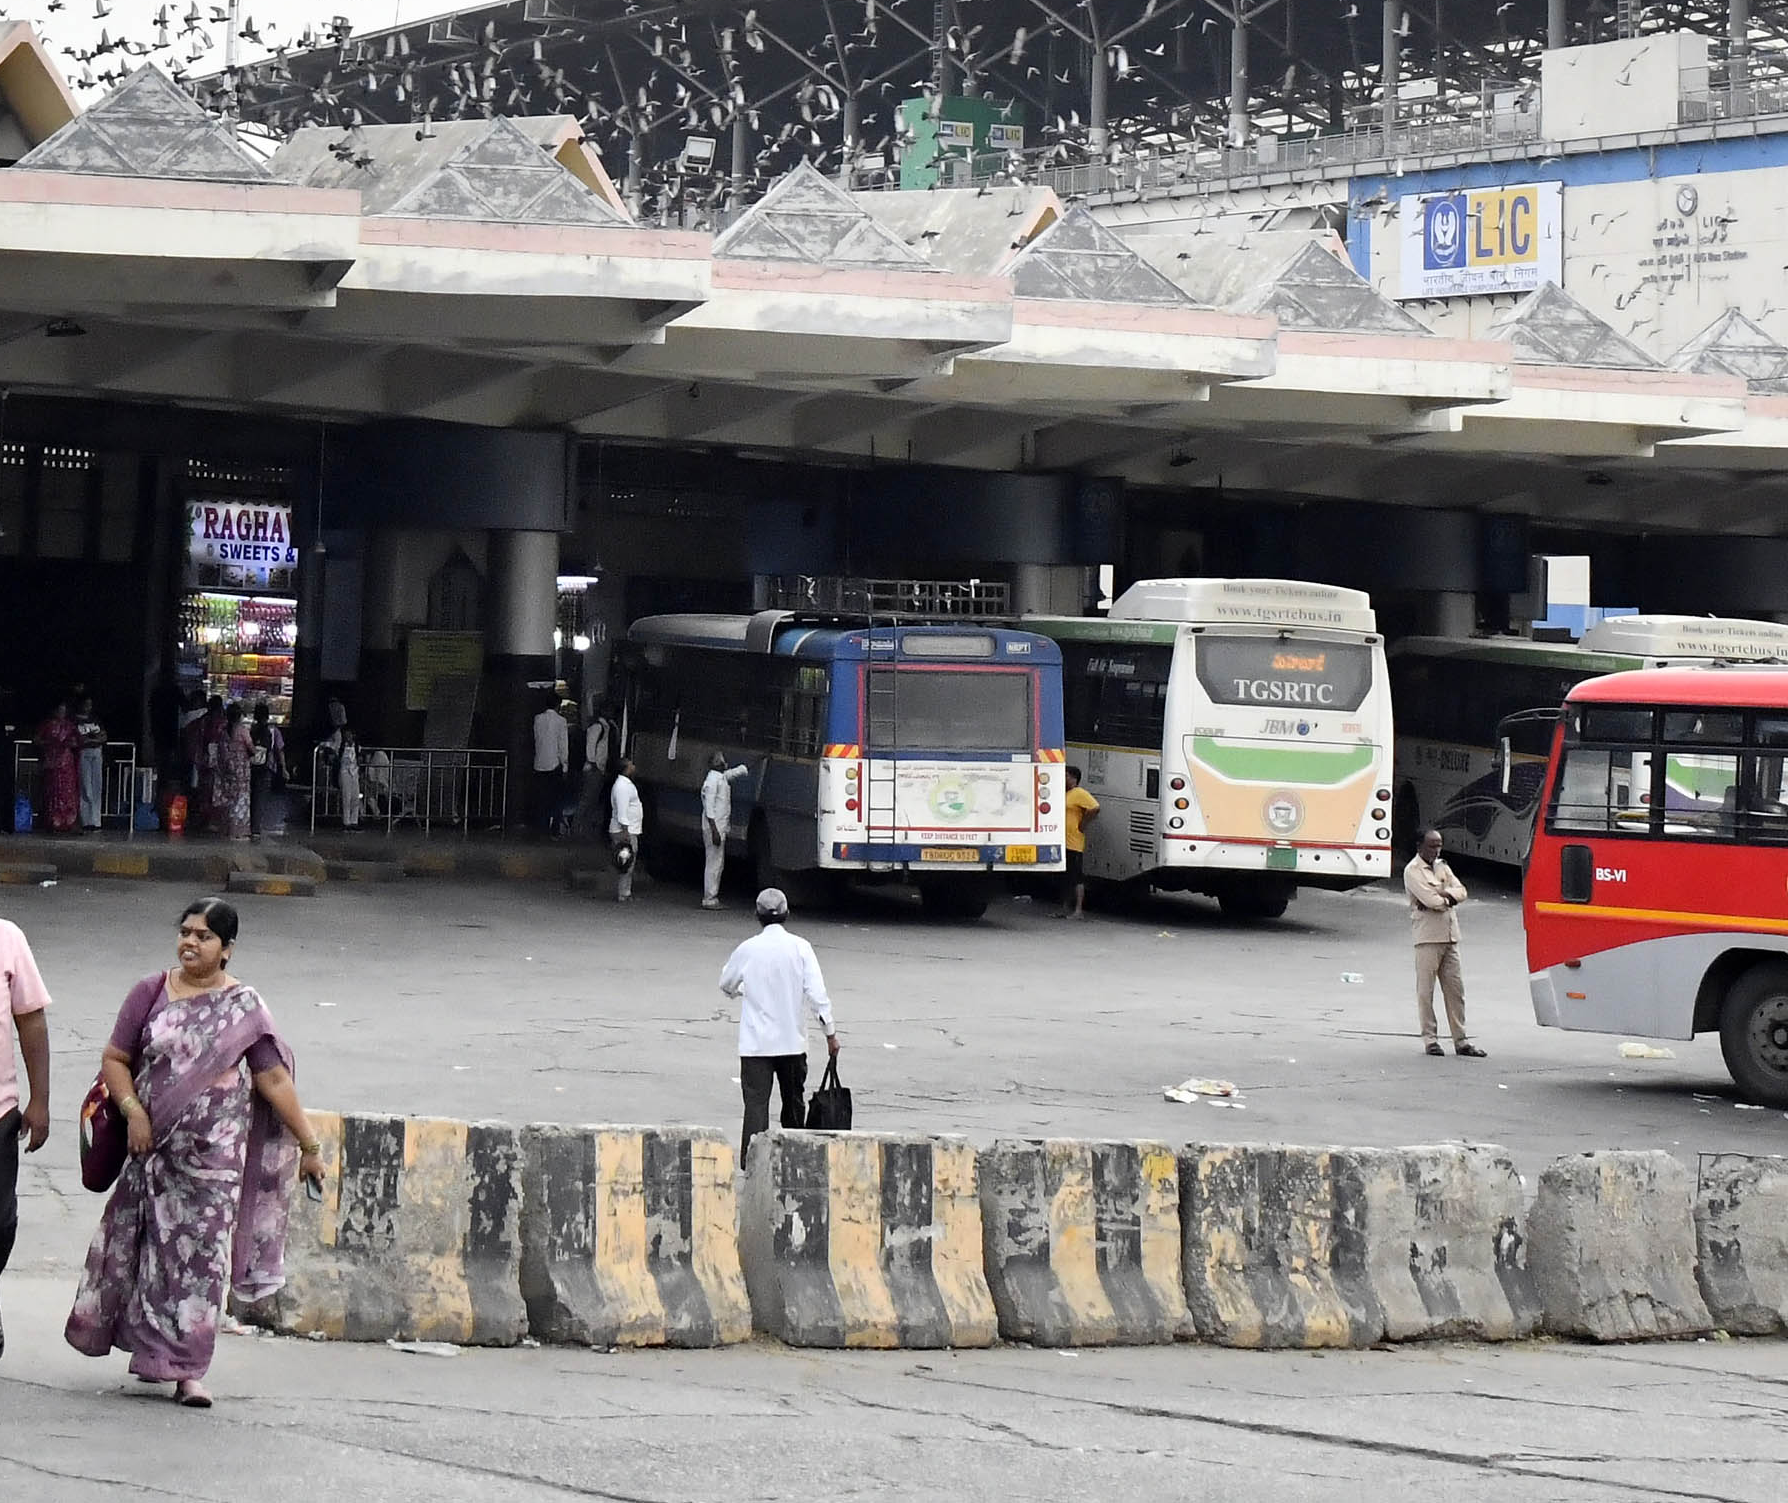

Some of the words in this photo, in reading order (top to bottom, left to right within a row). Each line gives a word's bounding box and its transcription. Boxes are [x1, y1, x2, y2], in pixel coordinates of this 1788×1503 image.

[1475, 195, 1531, 258] LIC
[219, 543, 280, 562] SWEETS
[285, 545, 296, 563] &
[1217, 605, 1343, 623] www.tgsrtcbus.in
[1677, 641, 1788, 658] www.tgsrtcbus.in
[1234, 678, 1334, 703] TGSRTC
[1260, 719, 1294, 736] JBM
[1040, 825, 1059, 833] STOP
[1595, 868, 1627, 882] BS-VI
